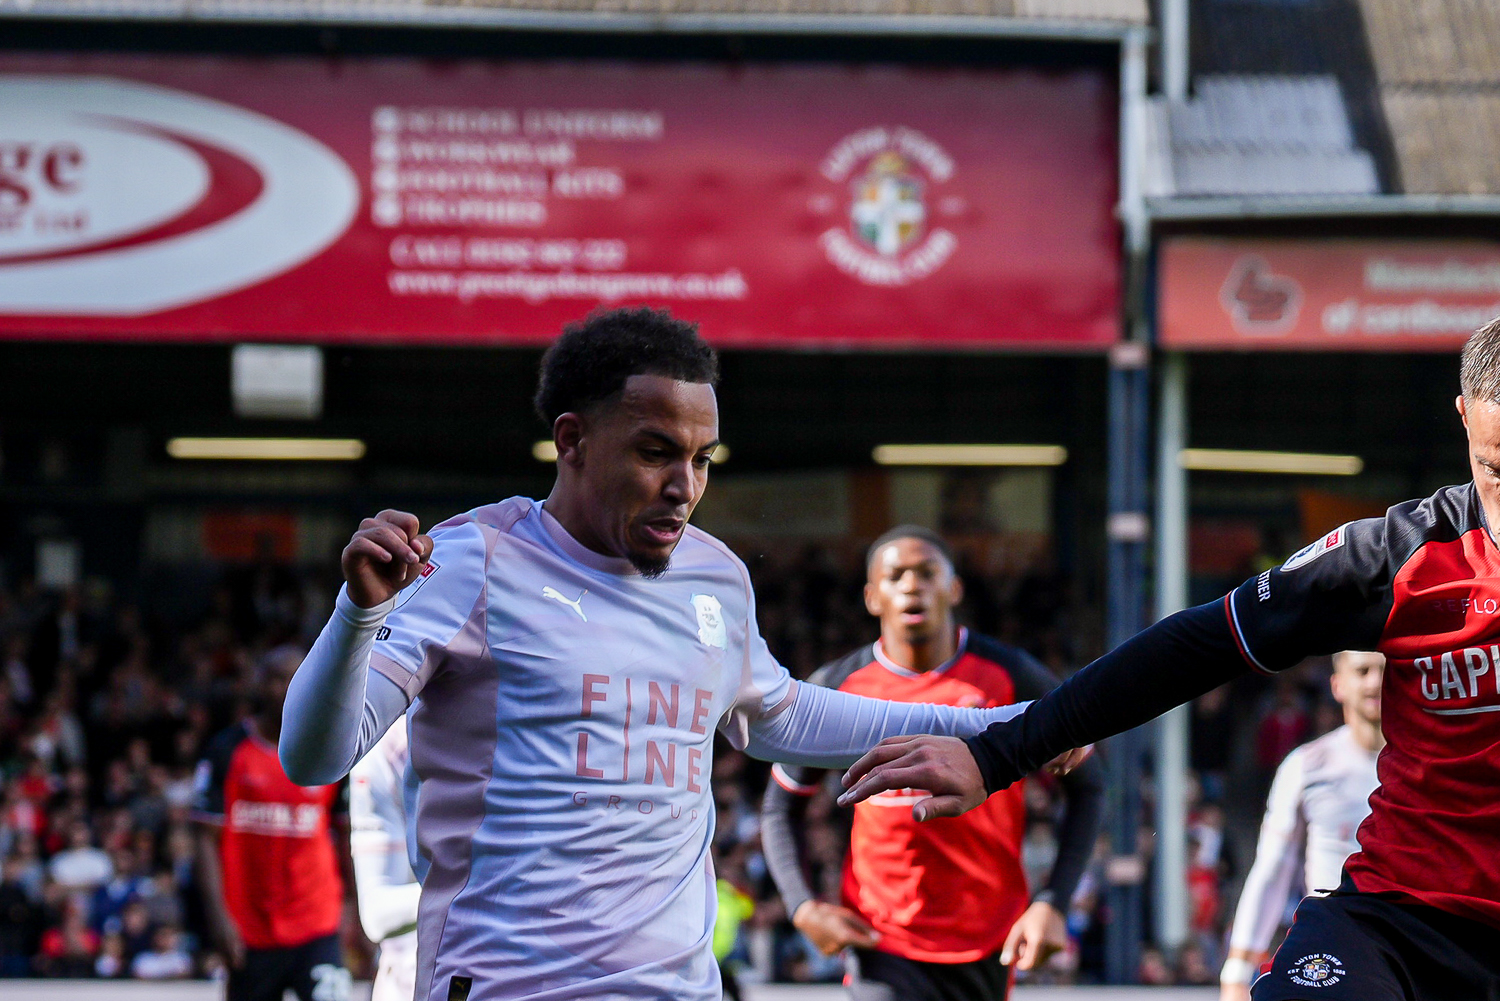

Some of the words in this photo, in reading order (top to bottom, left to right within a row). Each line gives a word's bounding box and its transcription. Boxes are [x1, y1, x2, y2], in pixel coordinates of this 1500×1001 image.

[580, 673, 713, 735] FINE
[576, 732, 702, 794] LINE
[572, 791, 698, 823] GROUP
